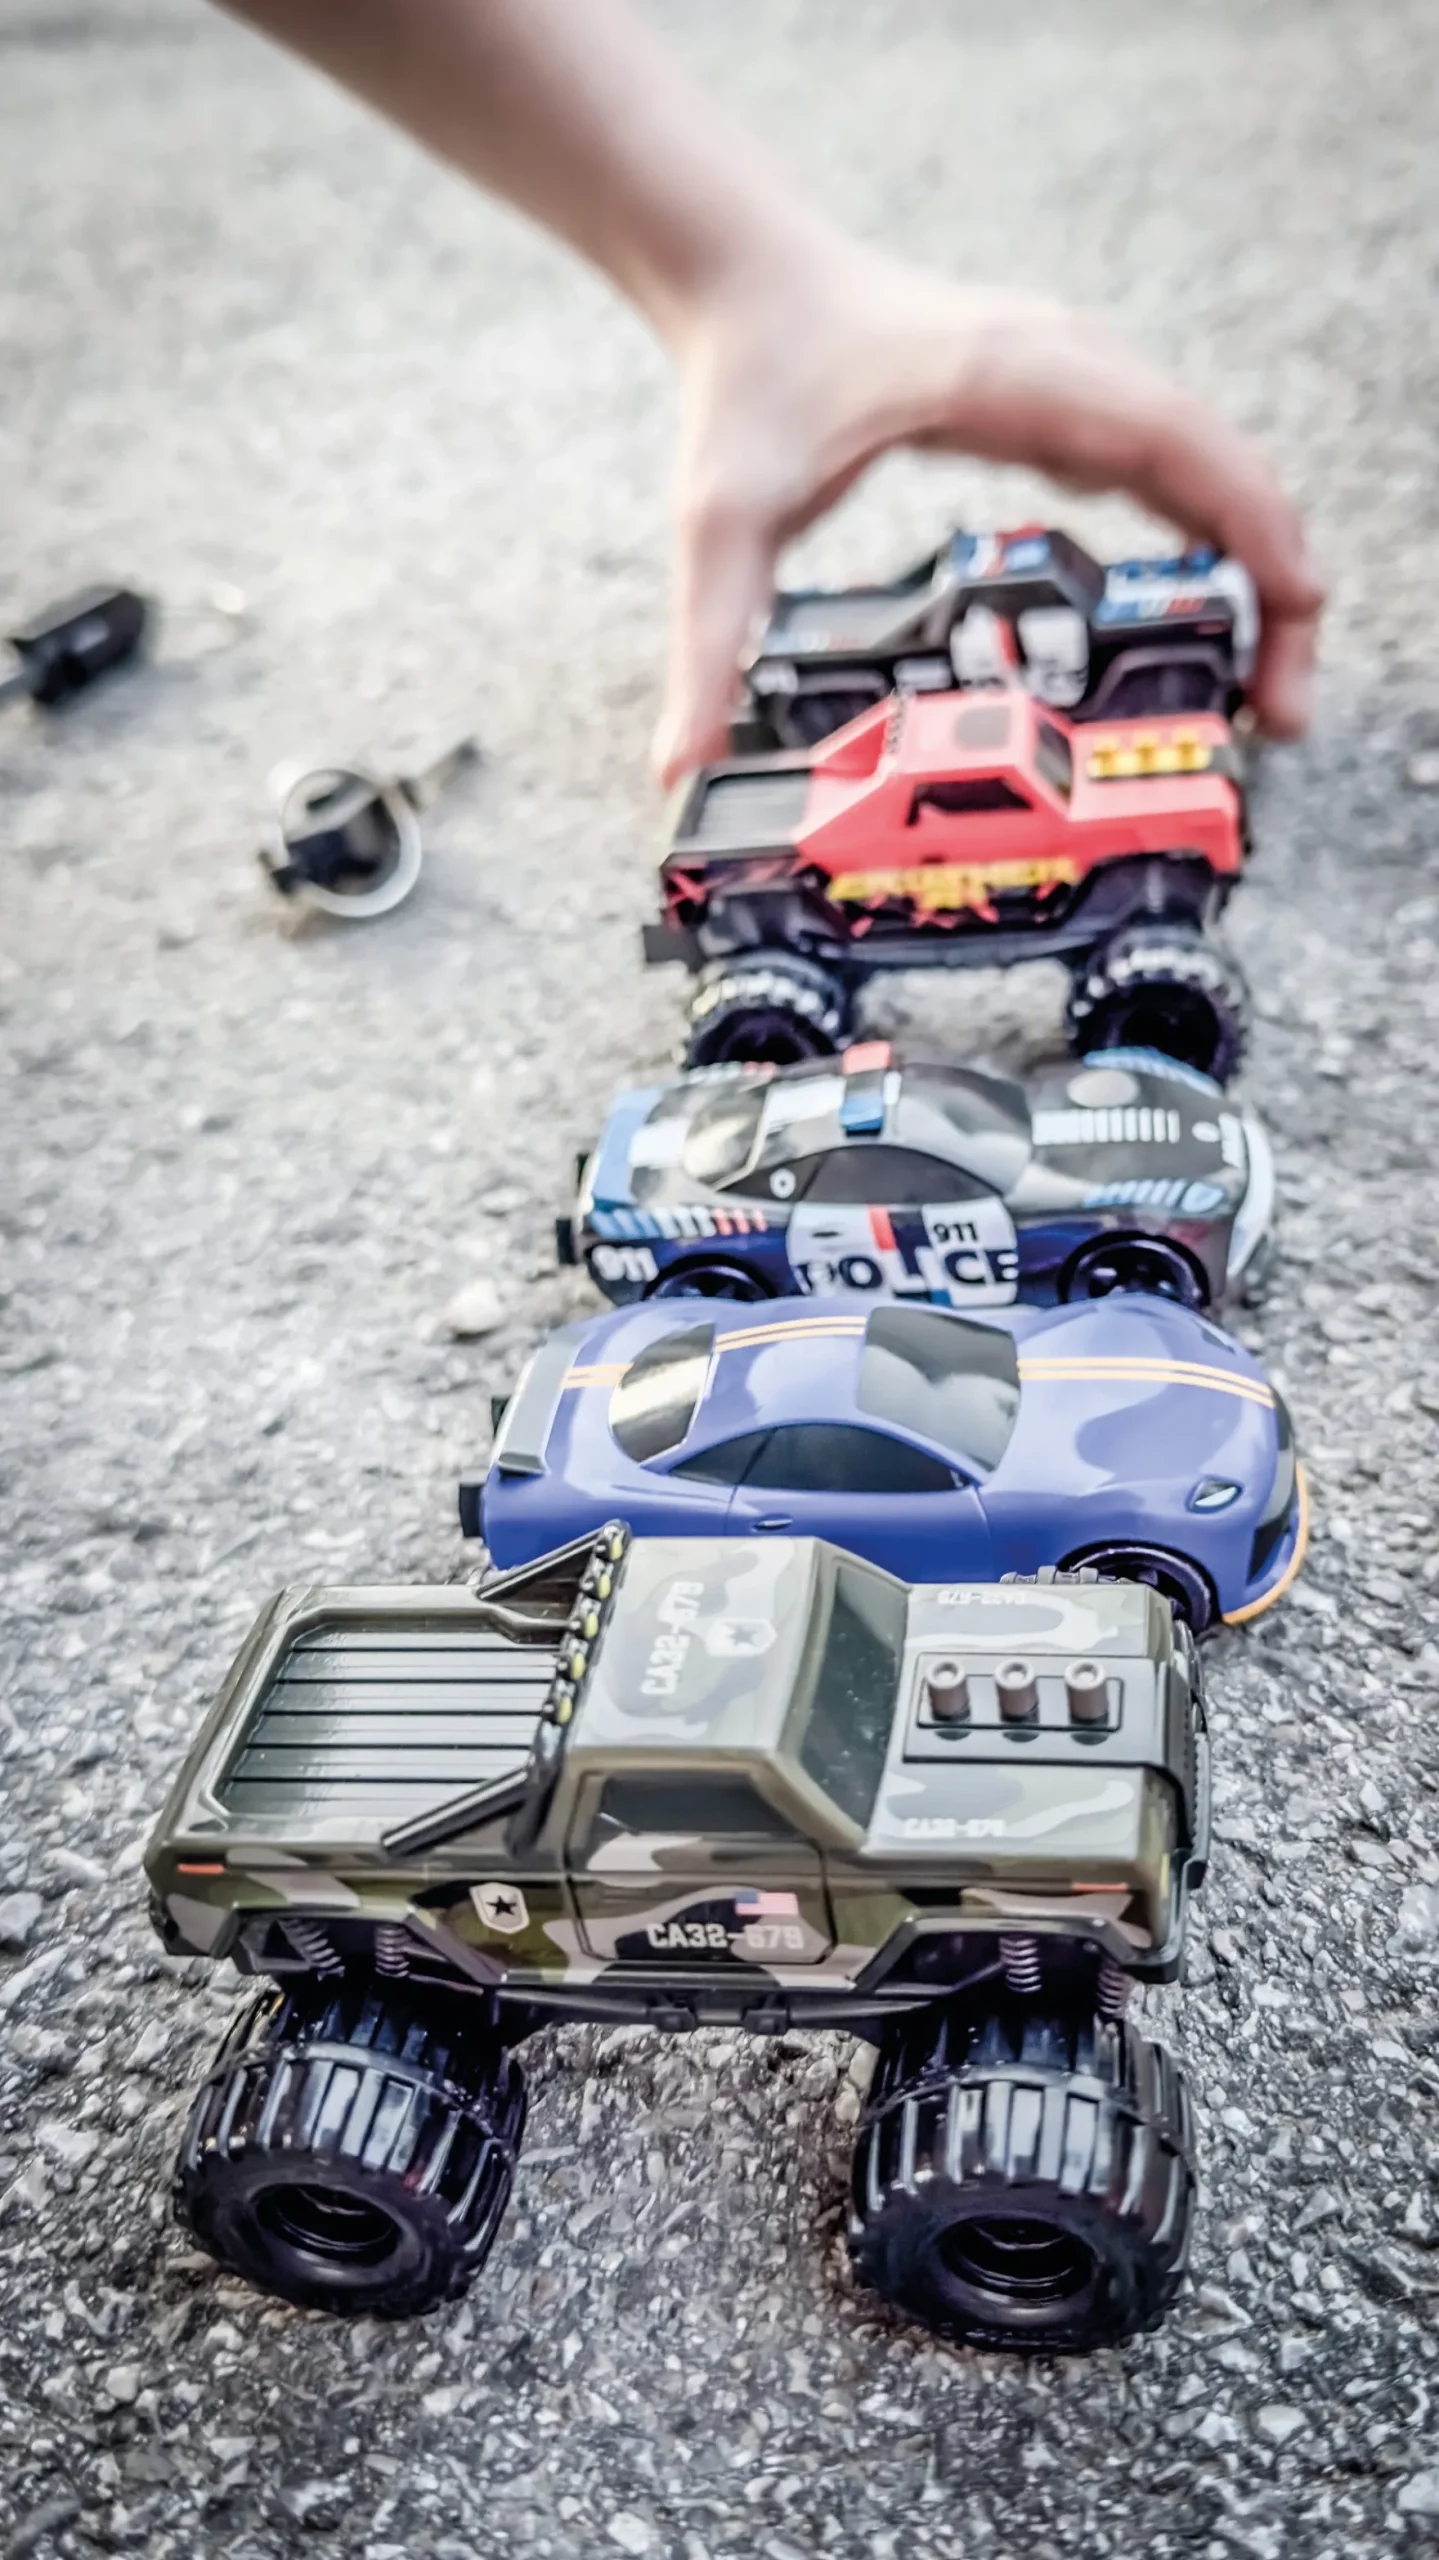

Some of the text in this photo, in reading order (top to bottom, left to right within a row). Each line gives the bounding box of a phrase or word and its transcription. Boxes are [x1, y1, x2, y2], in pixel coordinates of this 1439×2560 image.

[933, 1222, 979, 1243] 911
[591, 1244, 660, 1282] 911
[645, 1922, 805, 1950] CA32-679
